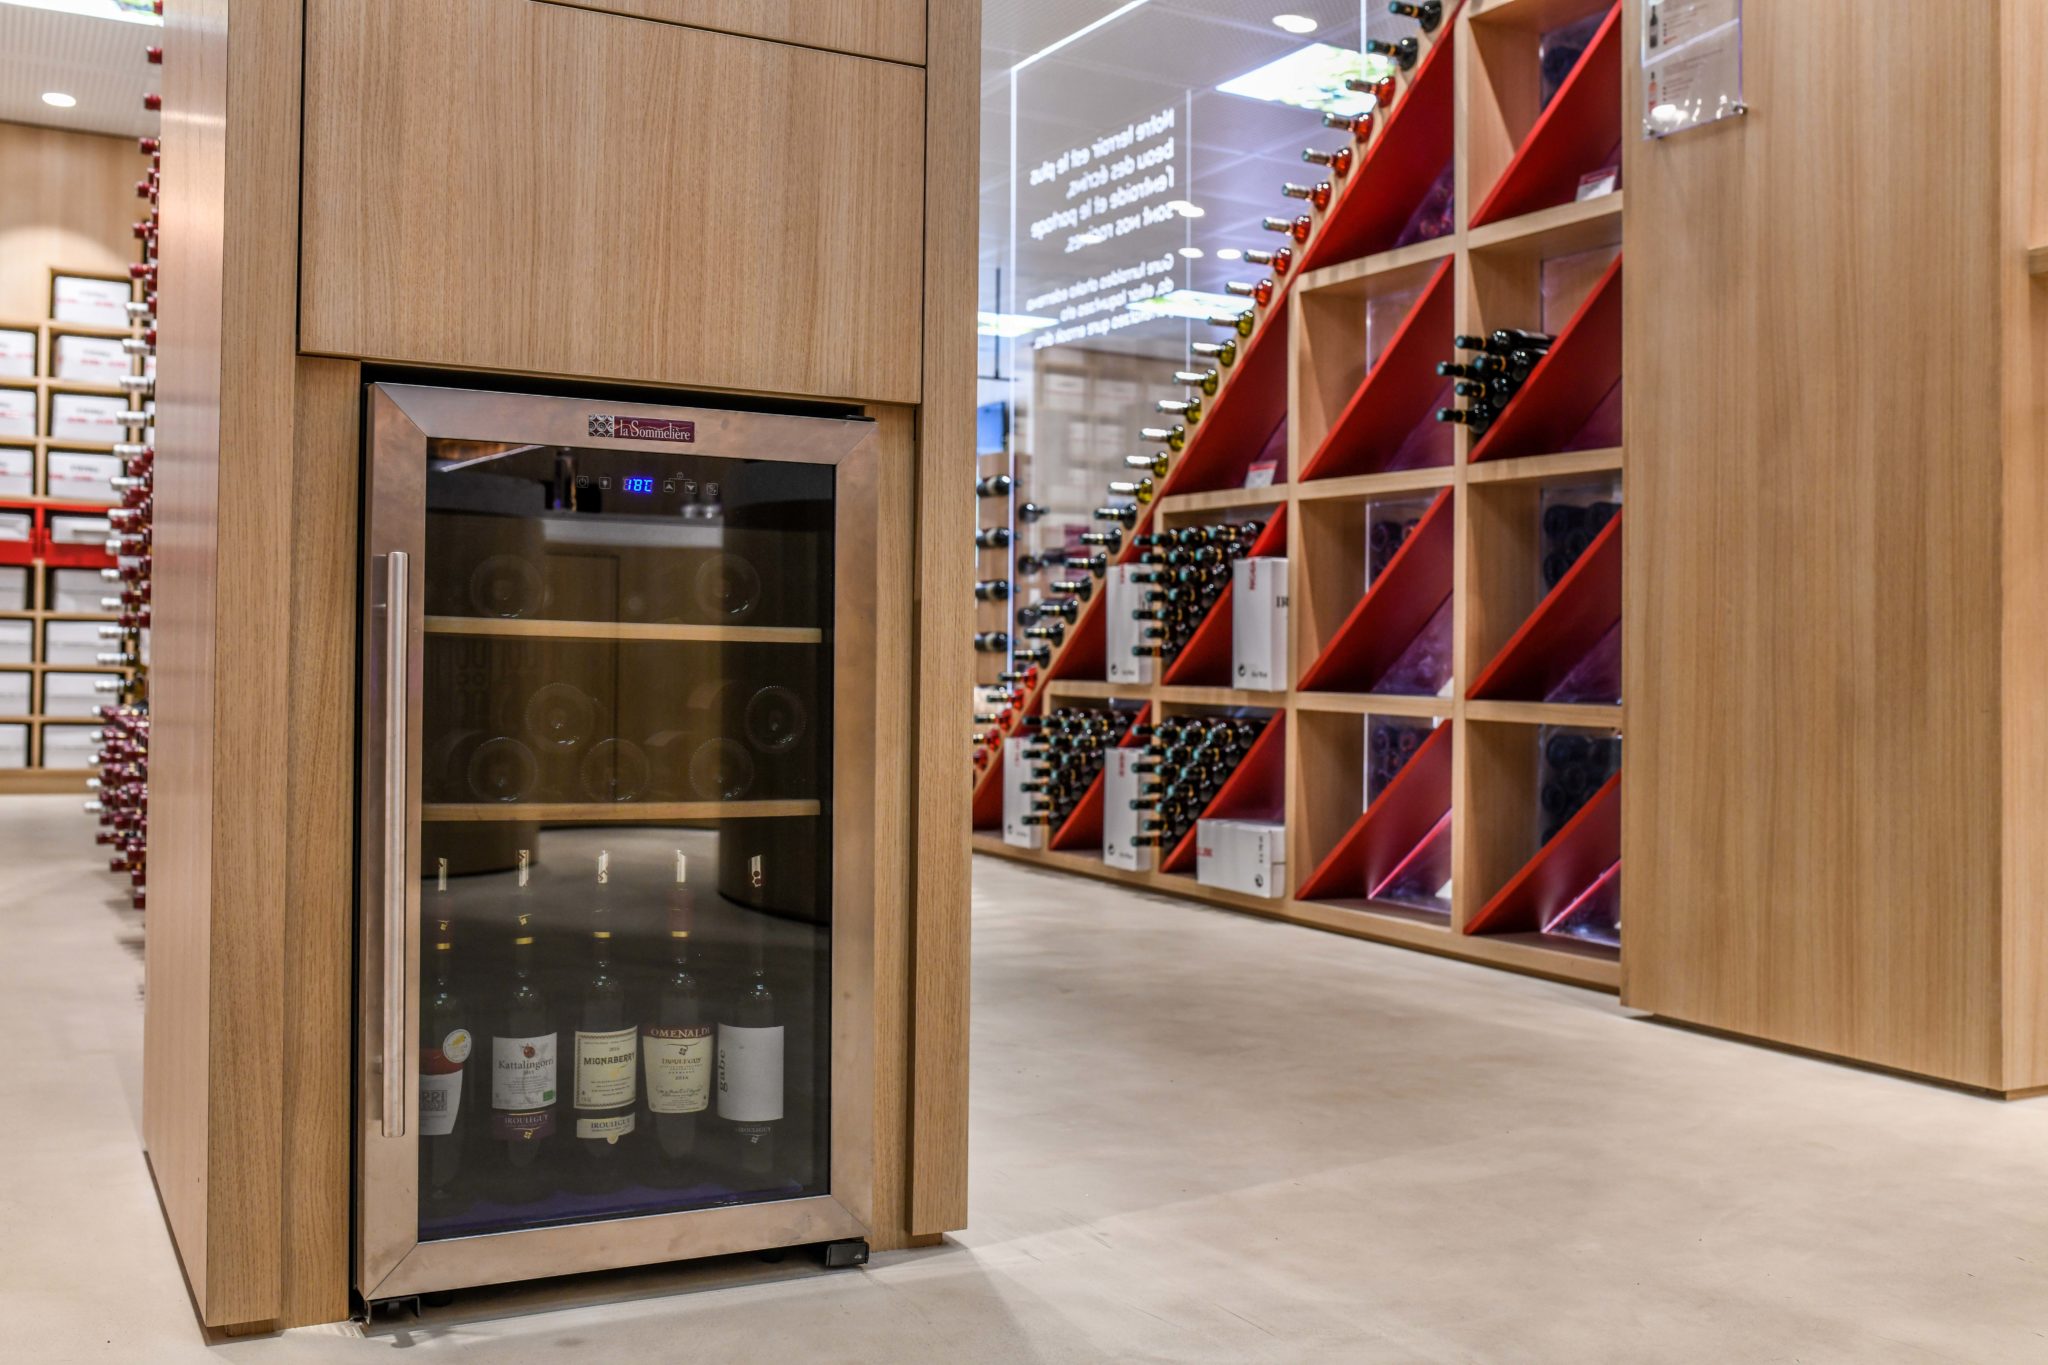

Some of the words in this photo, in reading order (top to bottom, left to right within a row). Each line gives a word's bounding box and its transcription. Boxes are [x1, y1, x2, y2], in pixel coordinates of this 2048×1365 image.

[619, 419, 629, 436] la
[630, 419, 691, 440] Sommelière
[650, 1027, 710, 1038] OMENALDI
